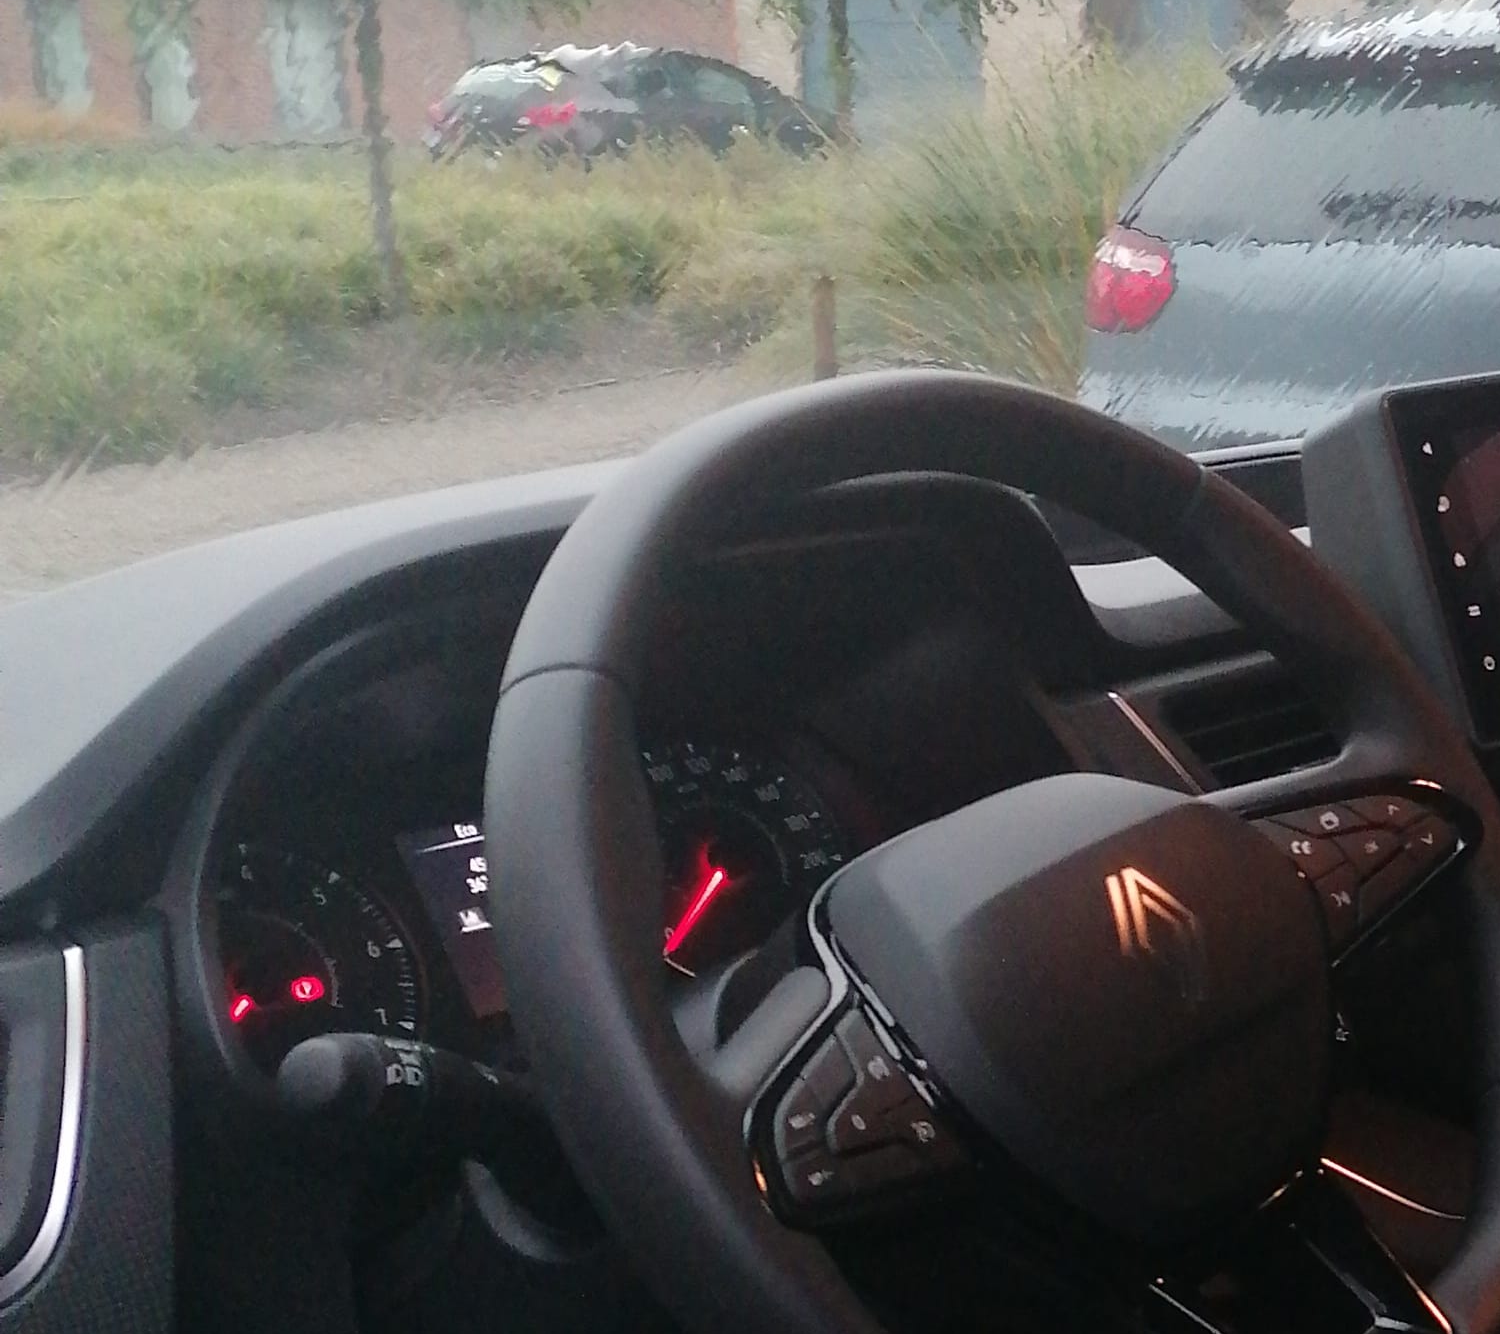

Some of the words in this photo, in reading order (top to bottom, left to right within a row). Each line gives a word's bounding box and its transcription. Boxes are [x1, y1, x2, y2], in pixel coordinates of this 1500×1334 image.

[312, 887, 327, 905] 5
[367, 940, 381, 958] 6
[374, 1008, 388, 1025] 7
